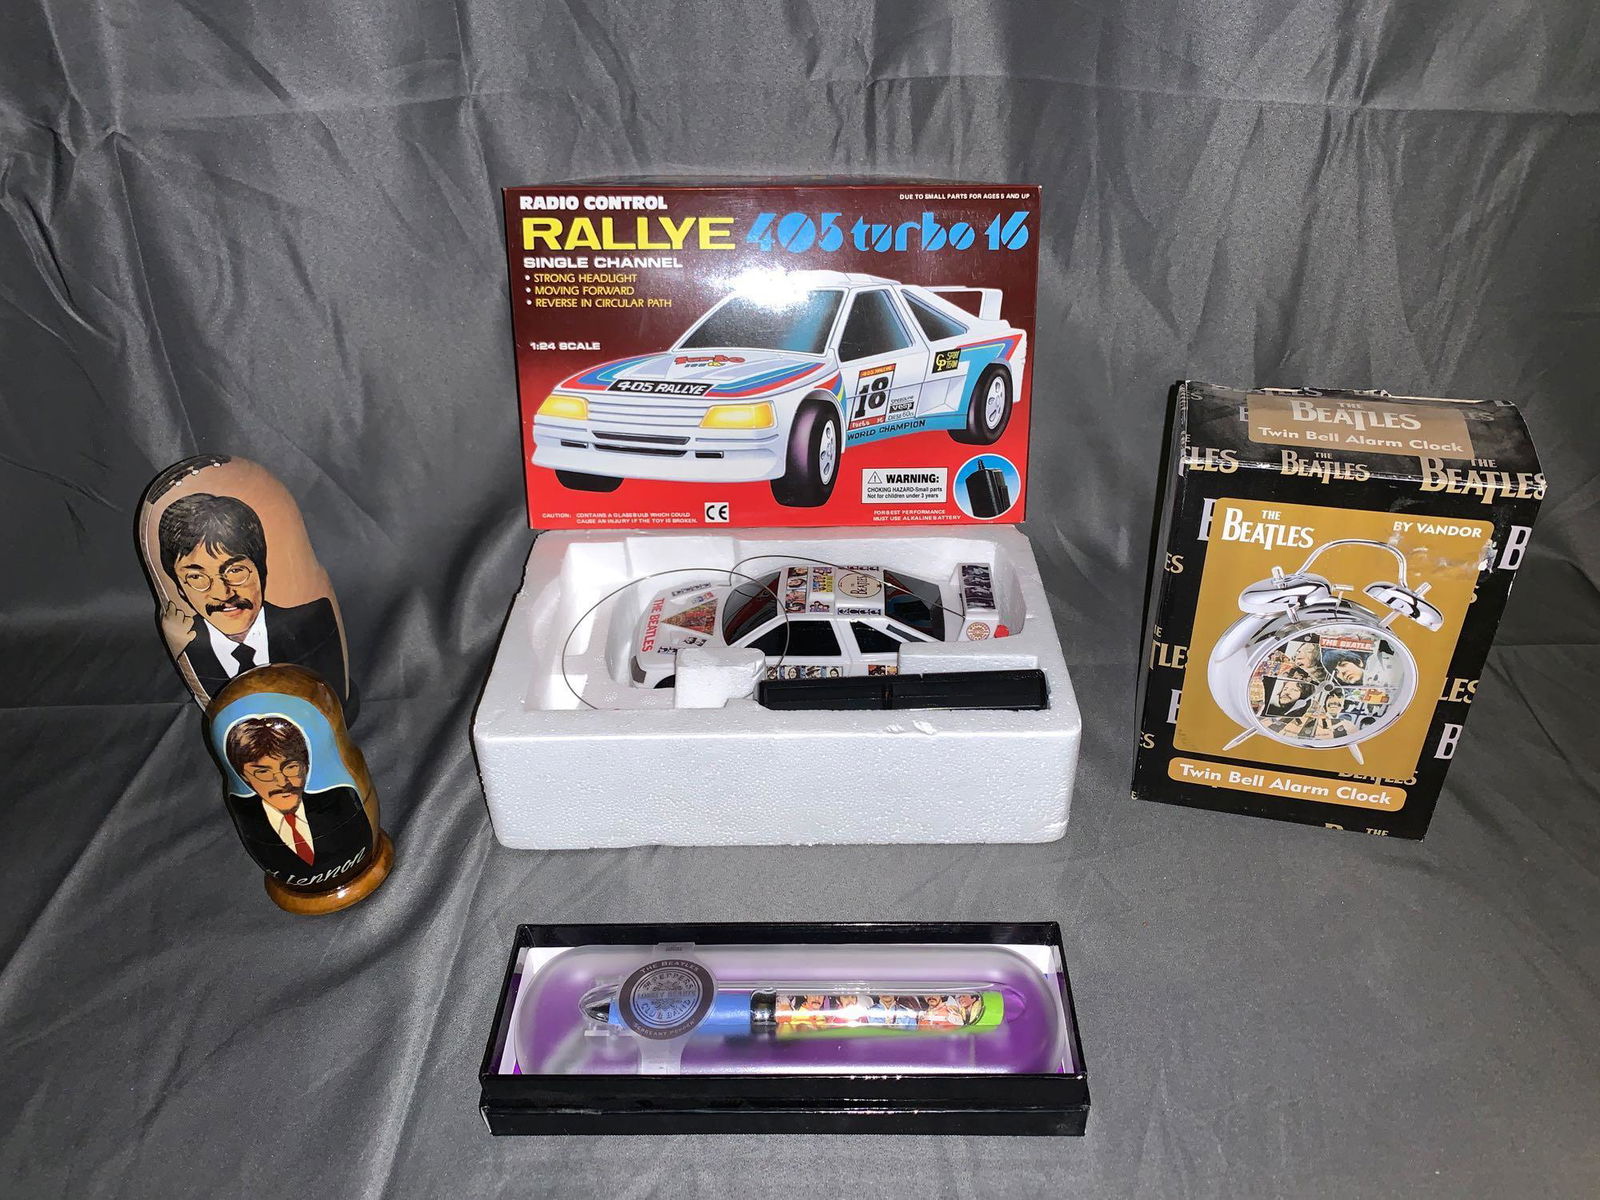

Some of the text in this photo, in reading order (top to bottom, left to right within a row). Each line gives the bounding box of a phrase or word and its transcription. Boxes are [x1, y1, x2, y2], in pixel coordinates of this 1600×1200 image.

[519, 195, 668, 211] RADIO CONTROL
[522, 211, 1030, 253] RALLYE 405 turbo 16
[523, 257, 683, 269] SINGLE CHANNEL
[534, 274, 638, 283] STRONG HEADLIGHT
[534, 286, 634, 296] MOVING FORWARD
[536, 298, 672, 308] REVERSE IN CIRCULAR PATH
[530, 342, 601, 350] 1:24 SCALE
[618, 380, 708, 394] 405 RALLYE
[855, 377, 889, 418] 18
[1289, 400, 1422, 431] BEATLES
[848, 420, 926, 440] WORLD CHAMPION
[1258, 427, 1464, 452] Twin Bell Alarm Clock
[1280, 450, 1370, 484] BEATLES
[1471, 458, 1498, 468] THE
[886, 474, 939, 484] WARNING:
[1419, 456, 1546, 504] BEATLES
[1262, 510, 1282, 520] THE
[1222, 507, 1315, 550] BEATLES
[1393, 522, 1482, 538] BY VANDOR
[642, 598, 665, 652] THE BEATLES
[1180, 763, 1222, 780] Twin
[1228, 771, 1263, 787] Bell
[1269, 777, 1329, 796] Alarm
[1336, 786, 1392, 805] Clock
